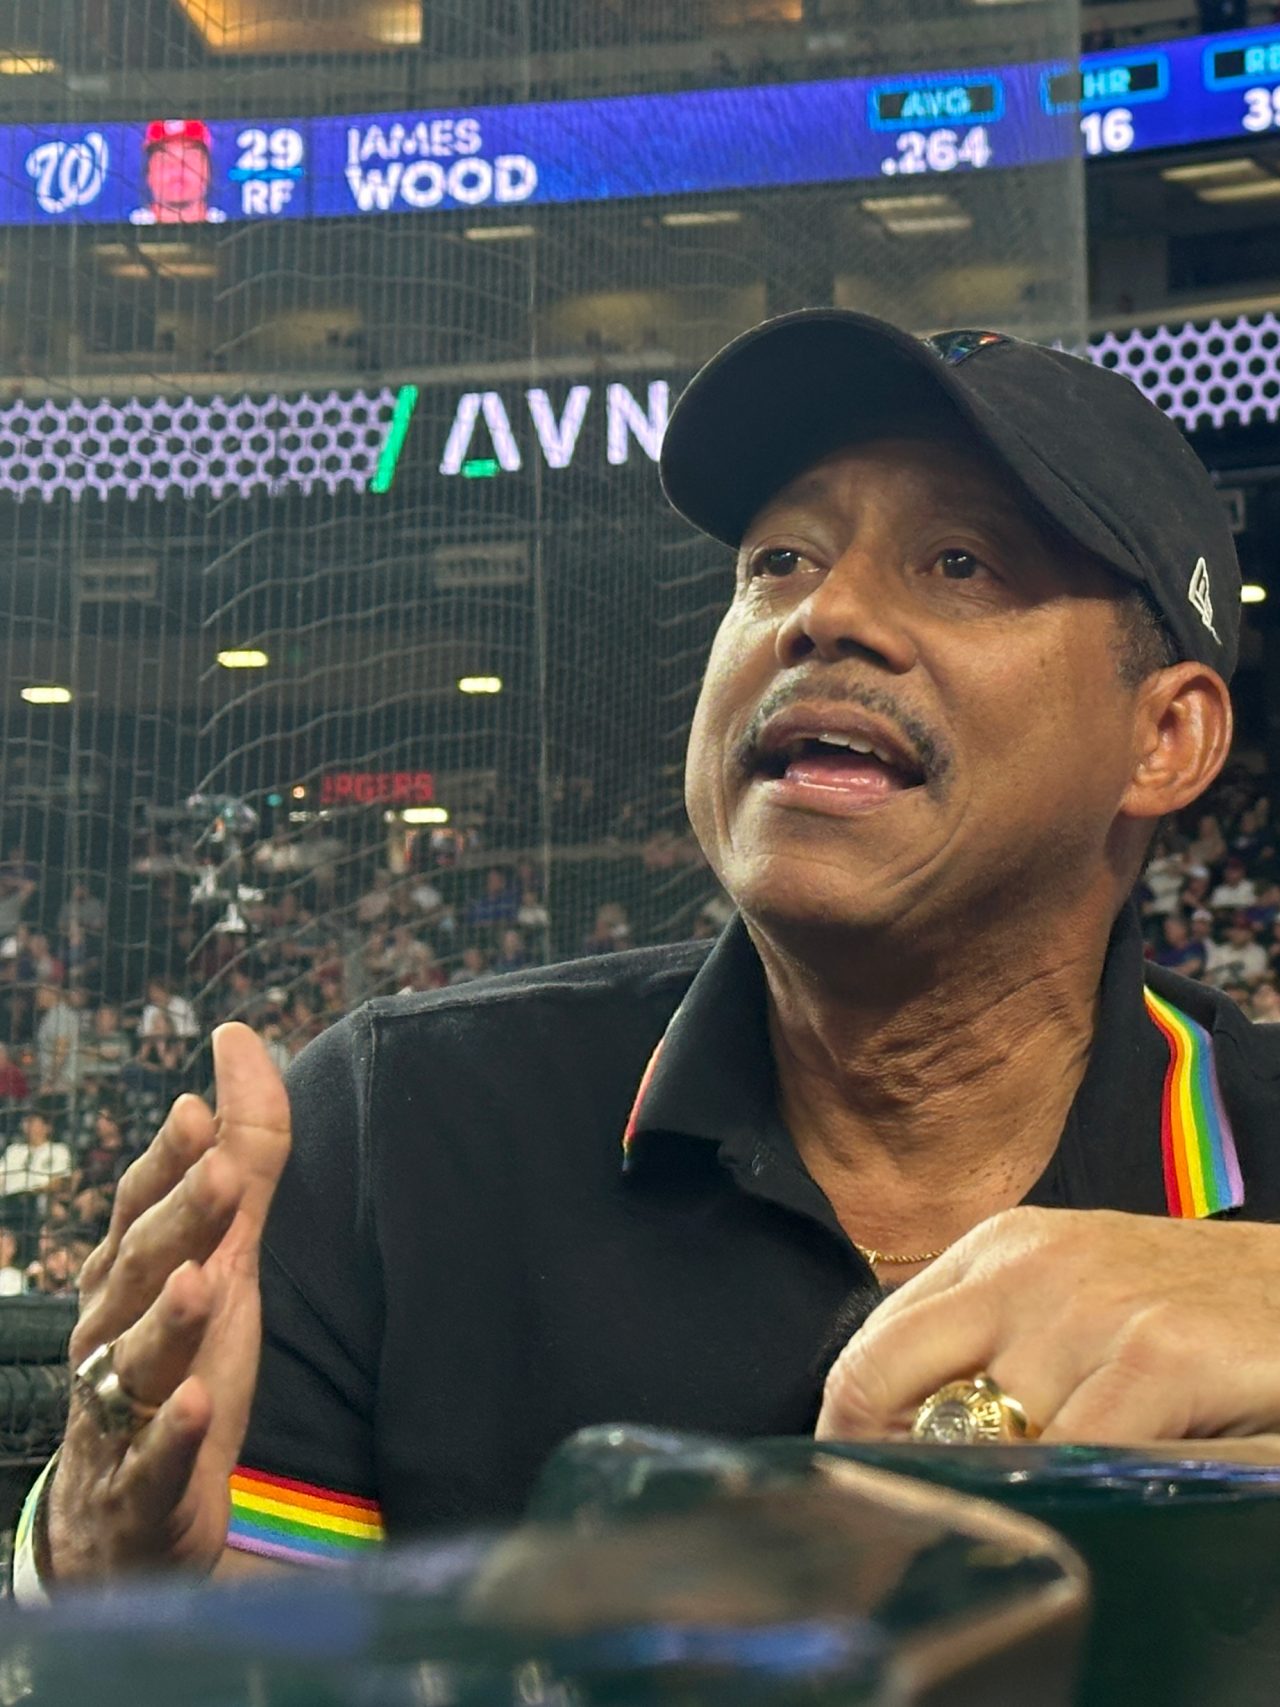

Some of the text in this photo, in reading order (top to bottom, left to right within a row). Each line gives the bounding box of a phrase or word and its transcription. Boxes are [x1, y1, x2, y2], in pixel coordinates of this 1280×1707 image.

[902, 86, 971, 118] AVG
[1083, 68, 1131, 98] HR
[236, 129, 303, 170] 29
[347, 118, 483, 165] JAMES
[881, 126, 991, 175] .264
[1080, 108, 1134, 155] 16
[241, 179, 295, 214] RF
[345, 154, 538, 211] WOOD
[439, 380, 669, 478] AVN
